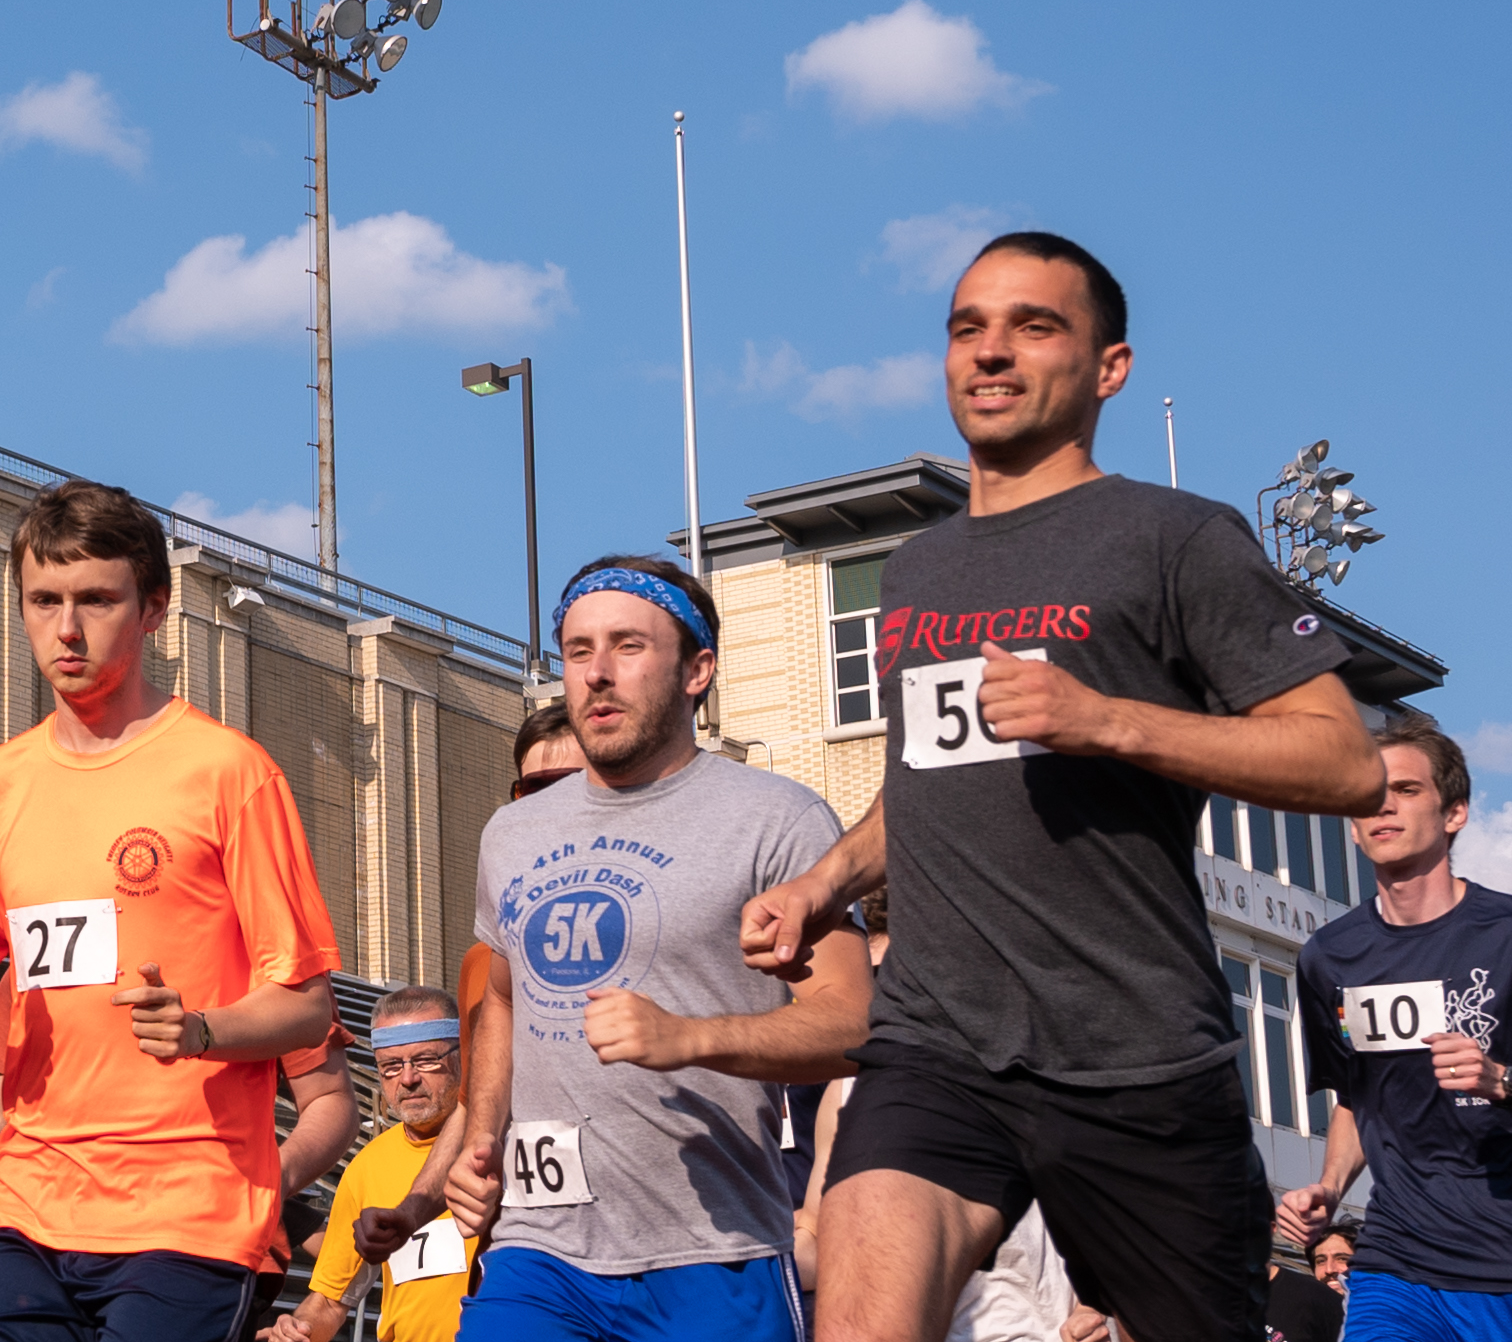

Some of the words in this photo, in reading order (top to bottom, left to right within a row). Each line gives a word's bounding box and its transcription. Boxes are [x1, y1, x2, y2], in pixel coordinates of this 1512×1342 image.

[909, 604, 1091, 661] RUTGERS
[532, 843, 575, 870] 4th
[590, 835, 674, 869] Annual
[143, 885, 160, 897] CLUB
[526, 869, 589, 902] Devil
[594, 868, 645, 898] Dash
[543, 901, 611, 963] 5K
[1266, 896, 1326, 935] STAD
[26, 915, 88, 977] 27
[1360, 994, 1420, 1042] 10
[514, 1135, 565, 1195] 46
